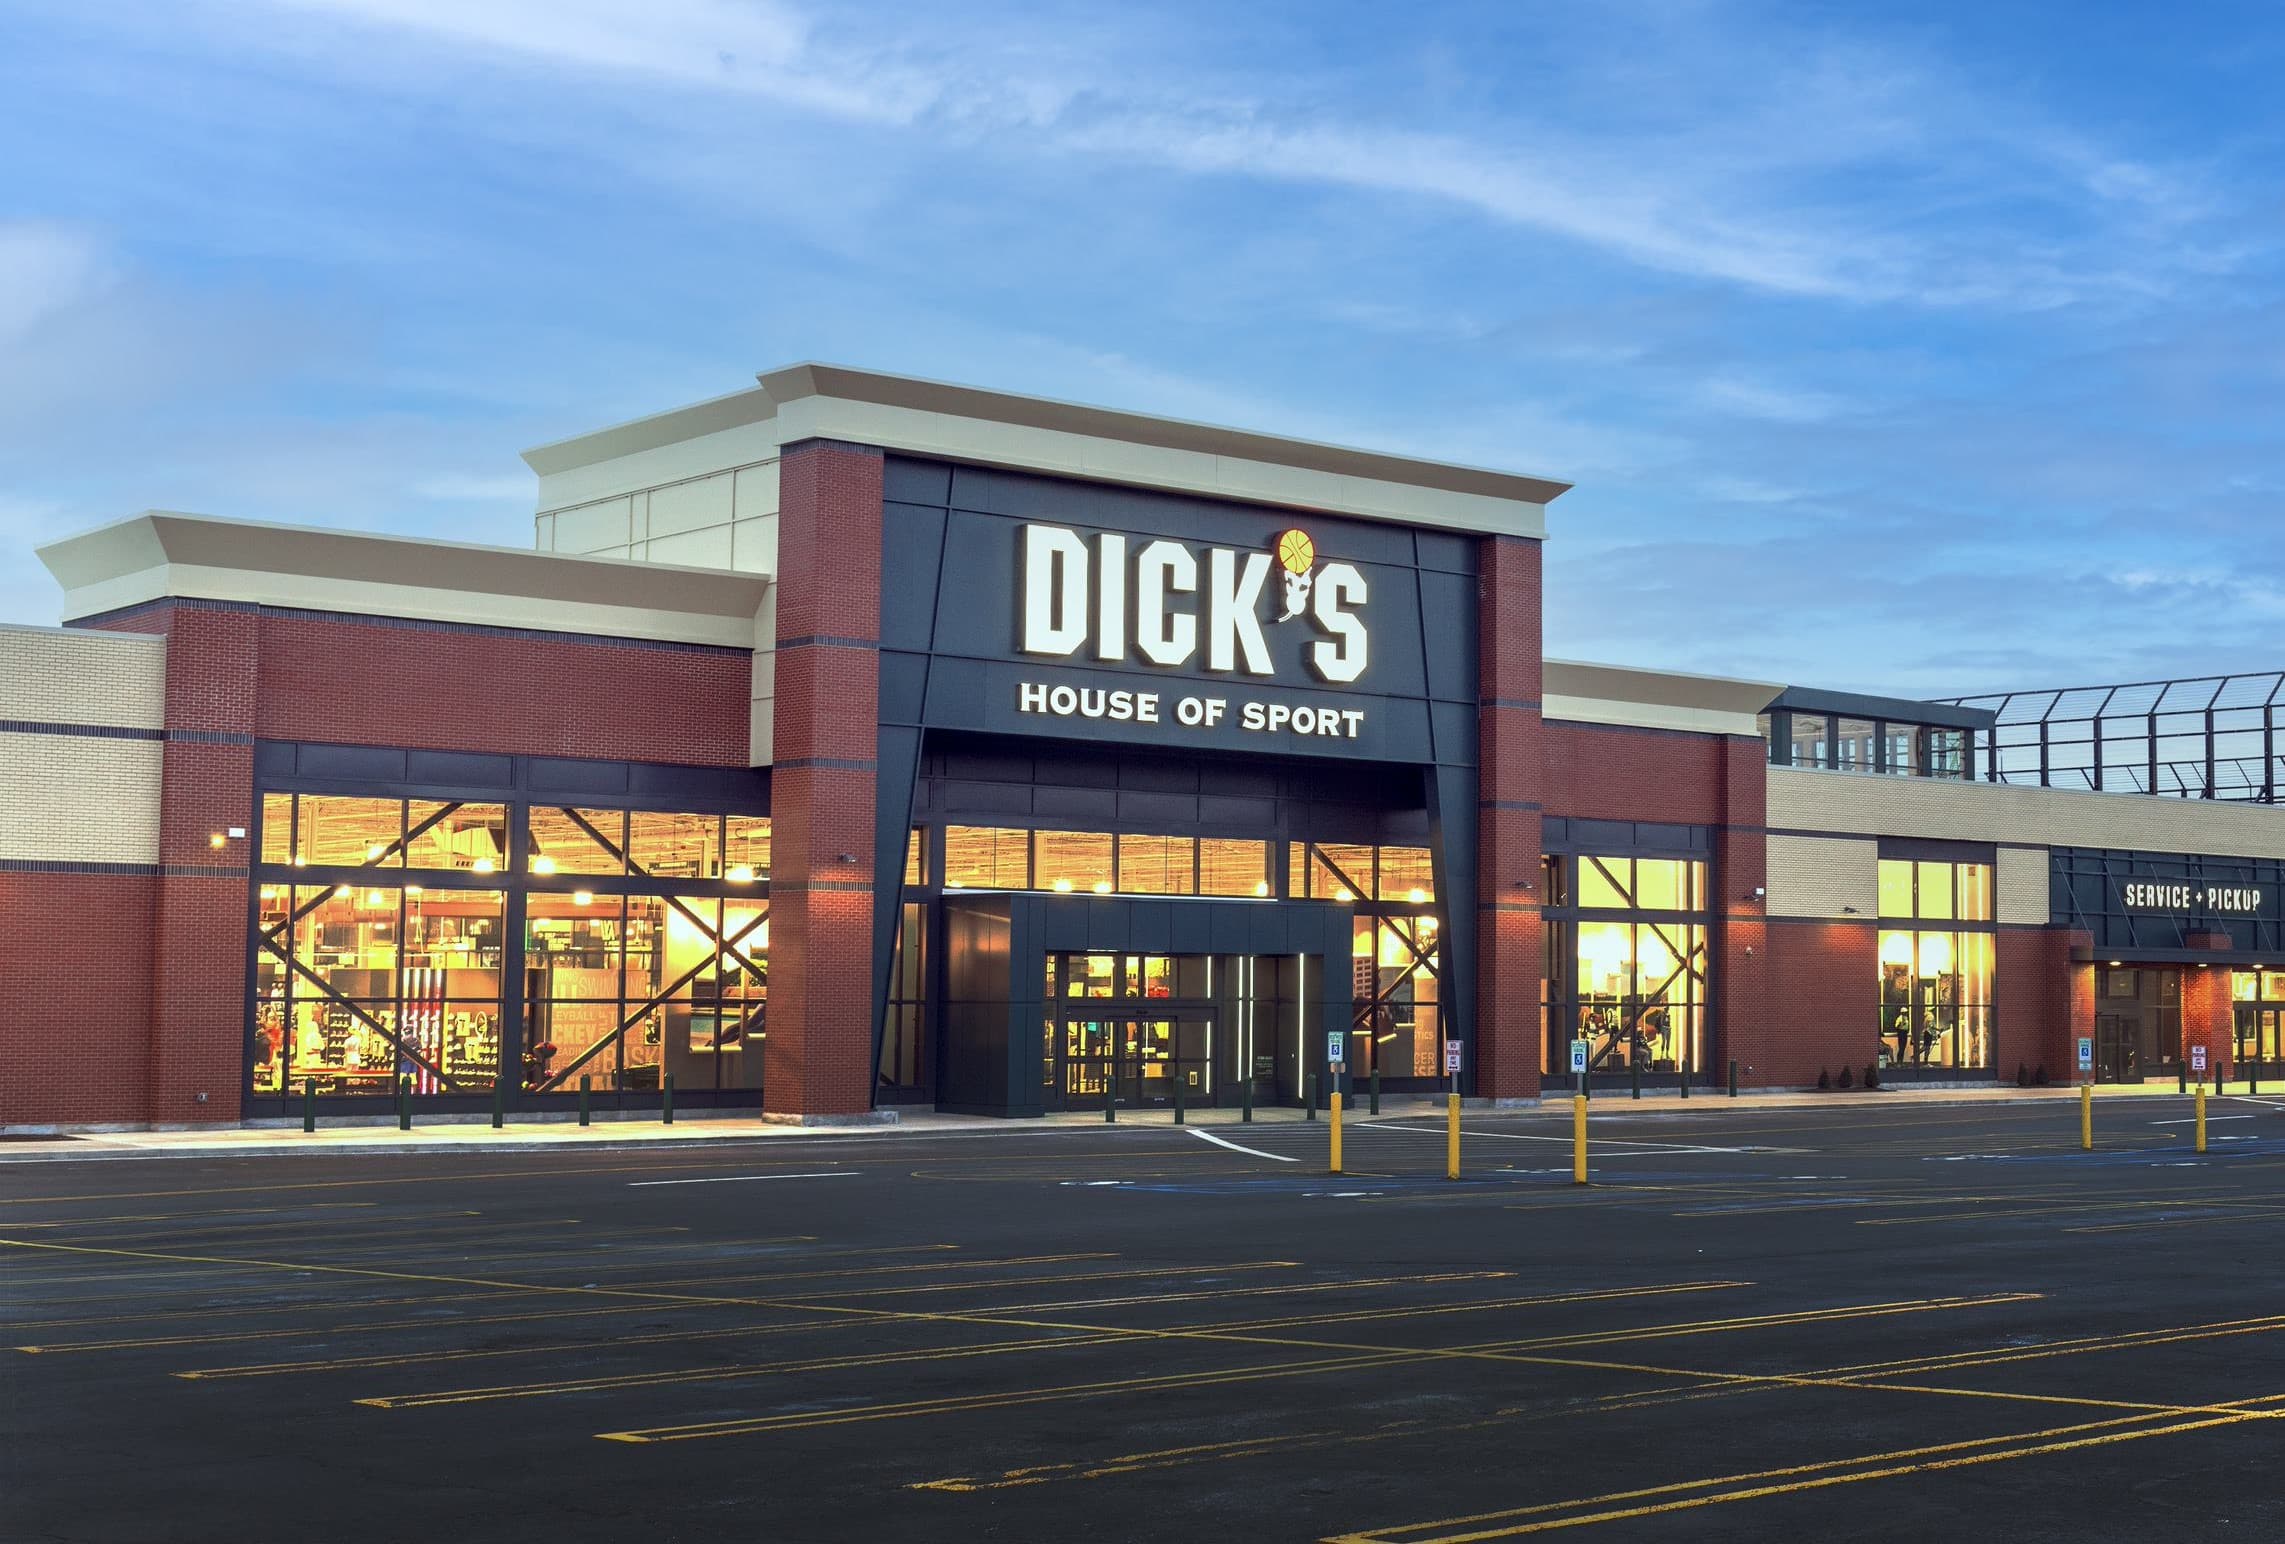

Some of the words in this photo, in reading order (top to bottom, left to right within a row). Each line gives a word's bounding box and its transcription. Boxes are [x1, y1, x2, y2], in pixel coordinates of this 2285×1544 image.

[1025, 524, 1367, 682] DICK'S
[1019, 682, 1159, 724] HOUSE
[1177, 697, 1227, 727] OF
[1242, 701, 1364, 738] SPORT
[2126, 883, 2190, 908] SERVICE
[2208, 887, 2261, 911] PICKUP
